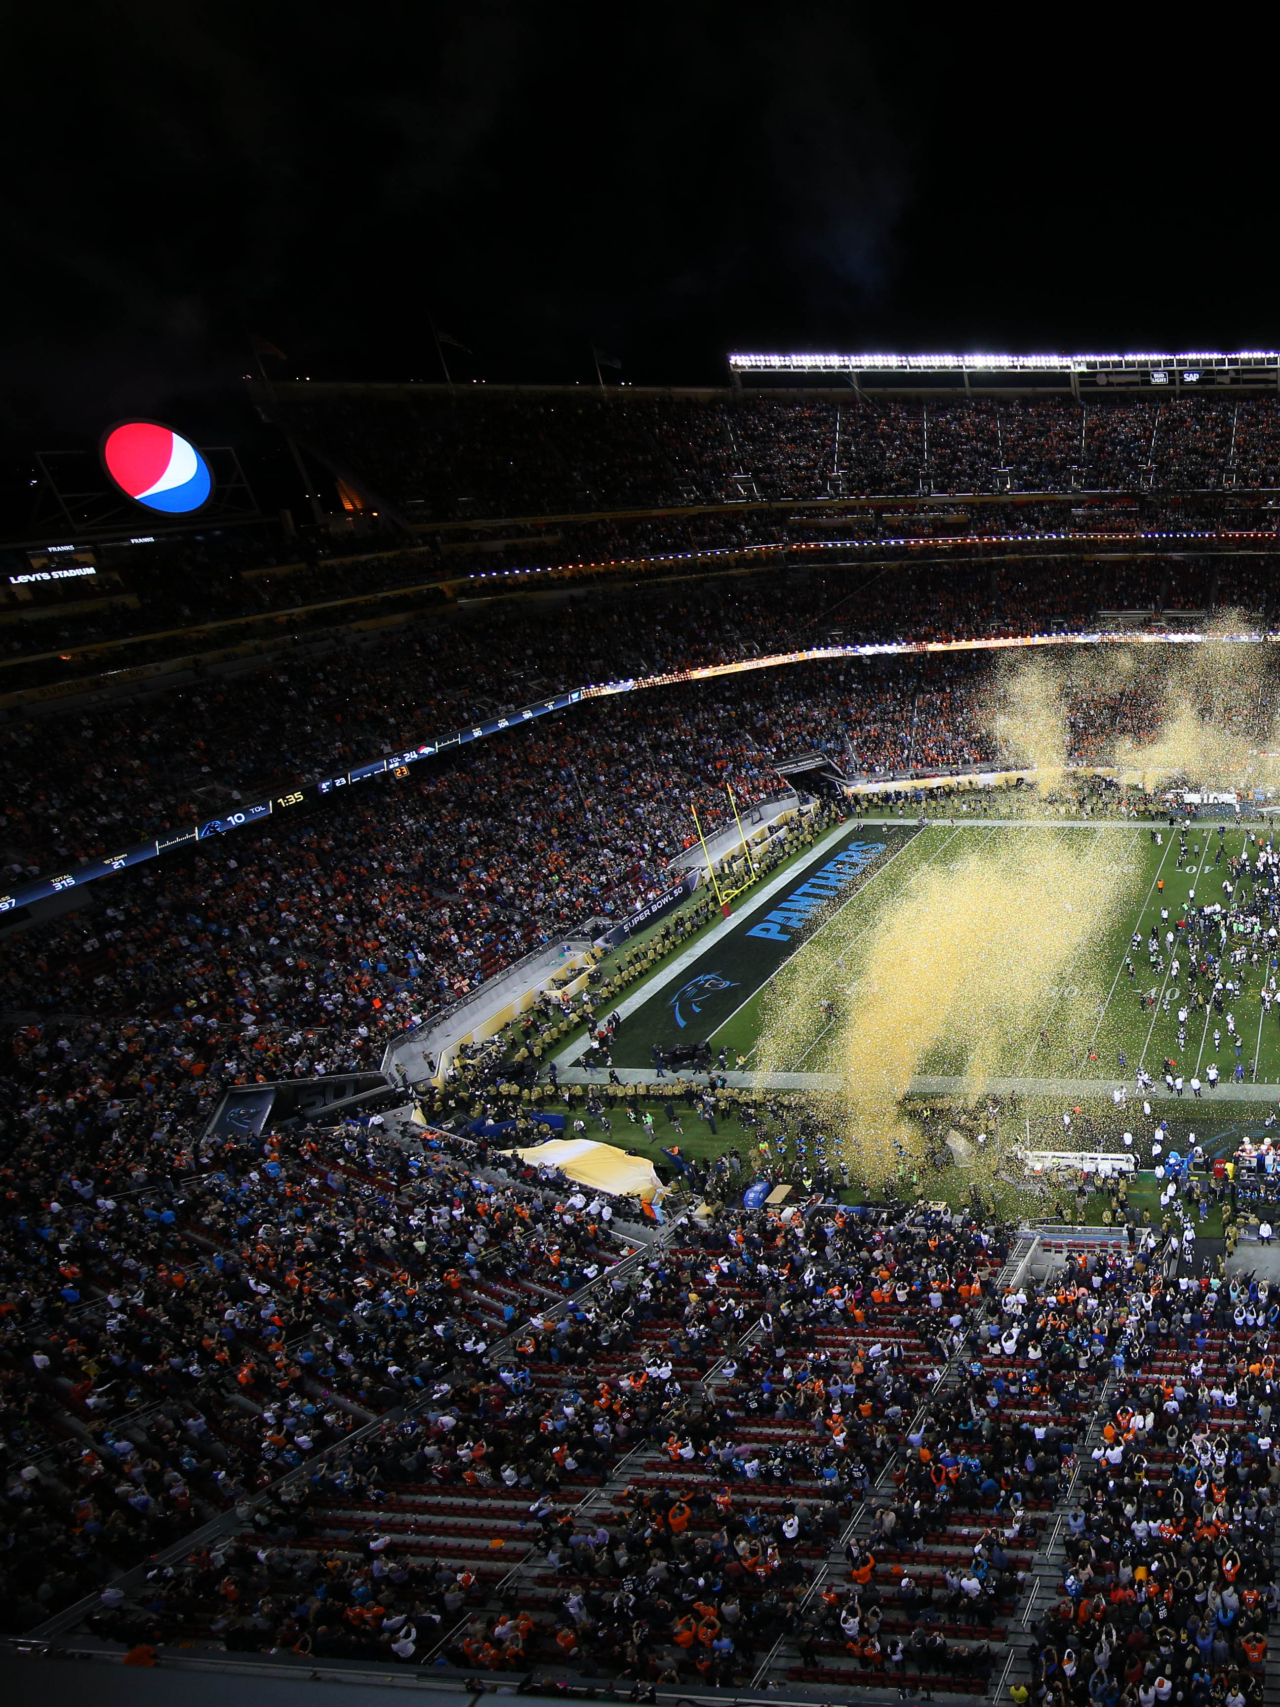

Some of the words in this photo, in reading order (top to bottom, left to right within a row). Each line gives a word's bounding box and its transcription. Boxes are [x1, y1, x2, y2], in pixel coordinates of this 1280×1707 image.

[1183, 373, 1200, 382] SAP
[51, 567, 97, 579] STADIUM
[38, 682, 84, 697] SUPER
[128, 669, 144, 678] 50
[472, 730, 483, 738] 90
[388, 756, 402, 764] TOL
[402, 750, 419, 762] 24
[395, 766, 408, 777] 23
[334, 777, 347, 787] 23
[277, 791, 304, 807] 1:35
[249, 805, 266, 814] TOL
[226, 812, 246, 825] 10
[111, 859, 126, 870] 21
[51, 874, 72, 883] TOTAL
[52, 877, 76, 891] 315
[745, 840, 887, 942] PANTHERS
[0, 899, 16, 911] 97
[623, 909, 651, 933] SUPER
[651, 895, 673, 913] BOWL
[673, 886, 684, 897] 50
[298, 1081, 355, 1117] 50
